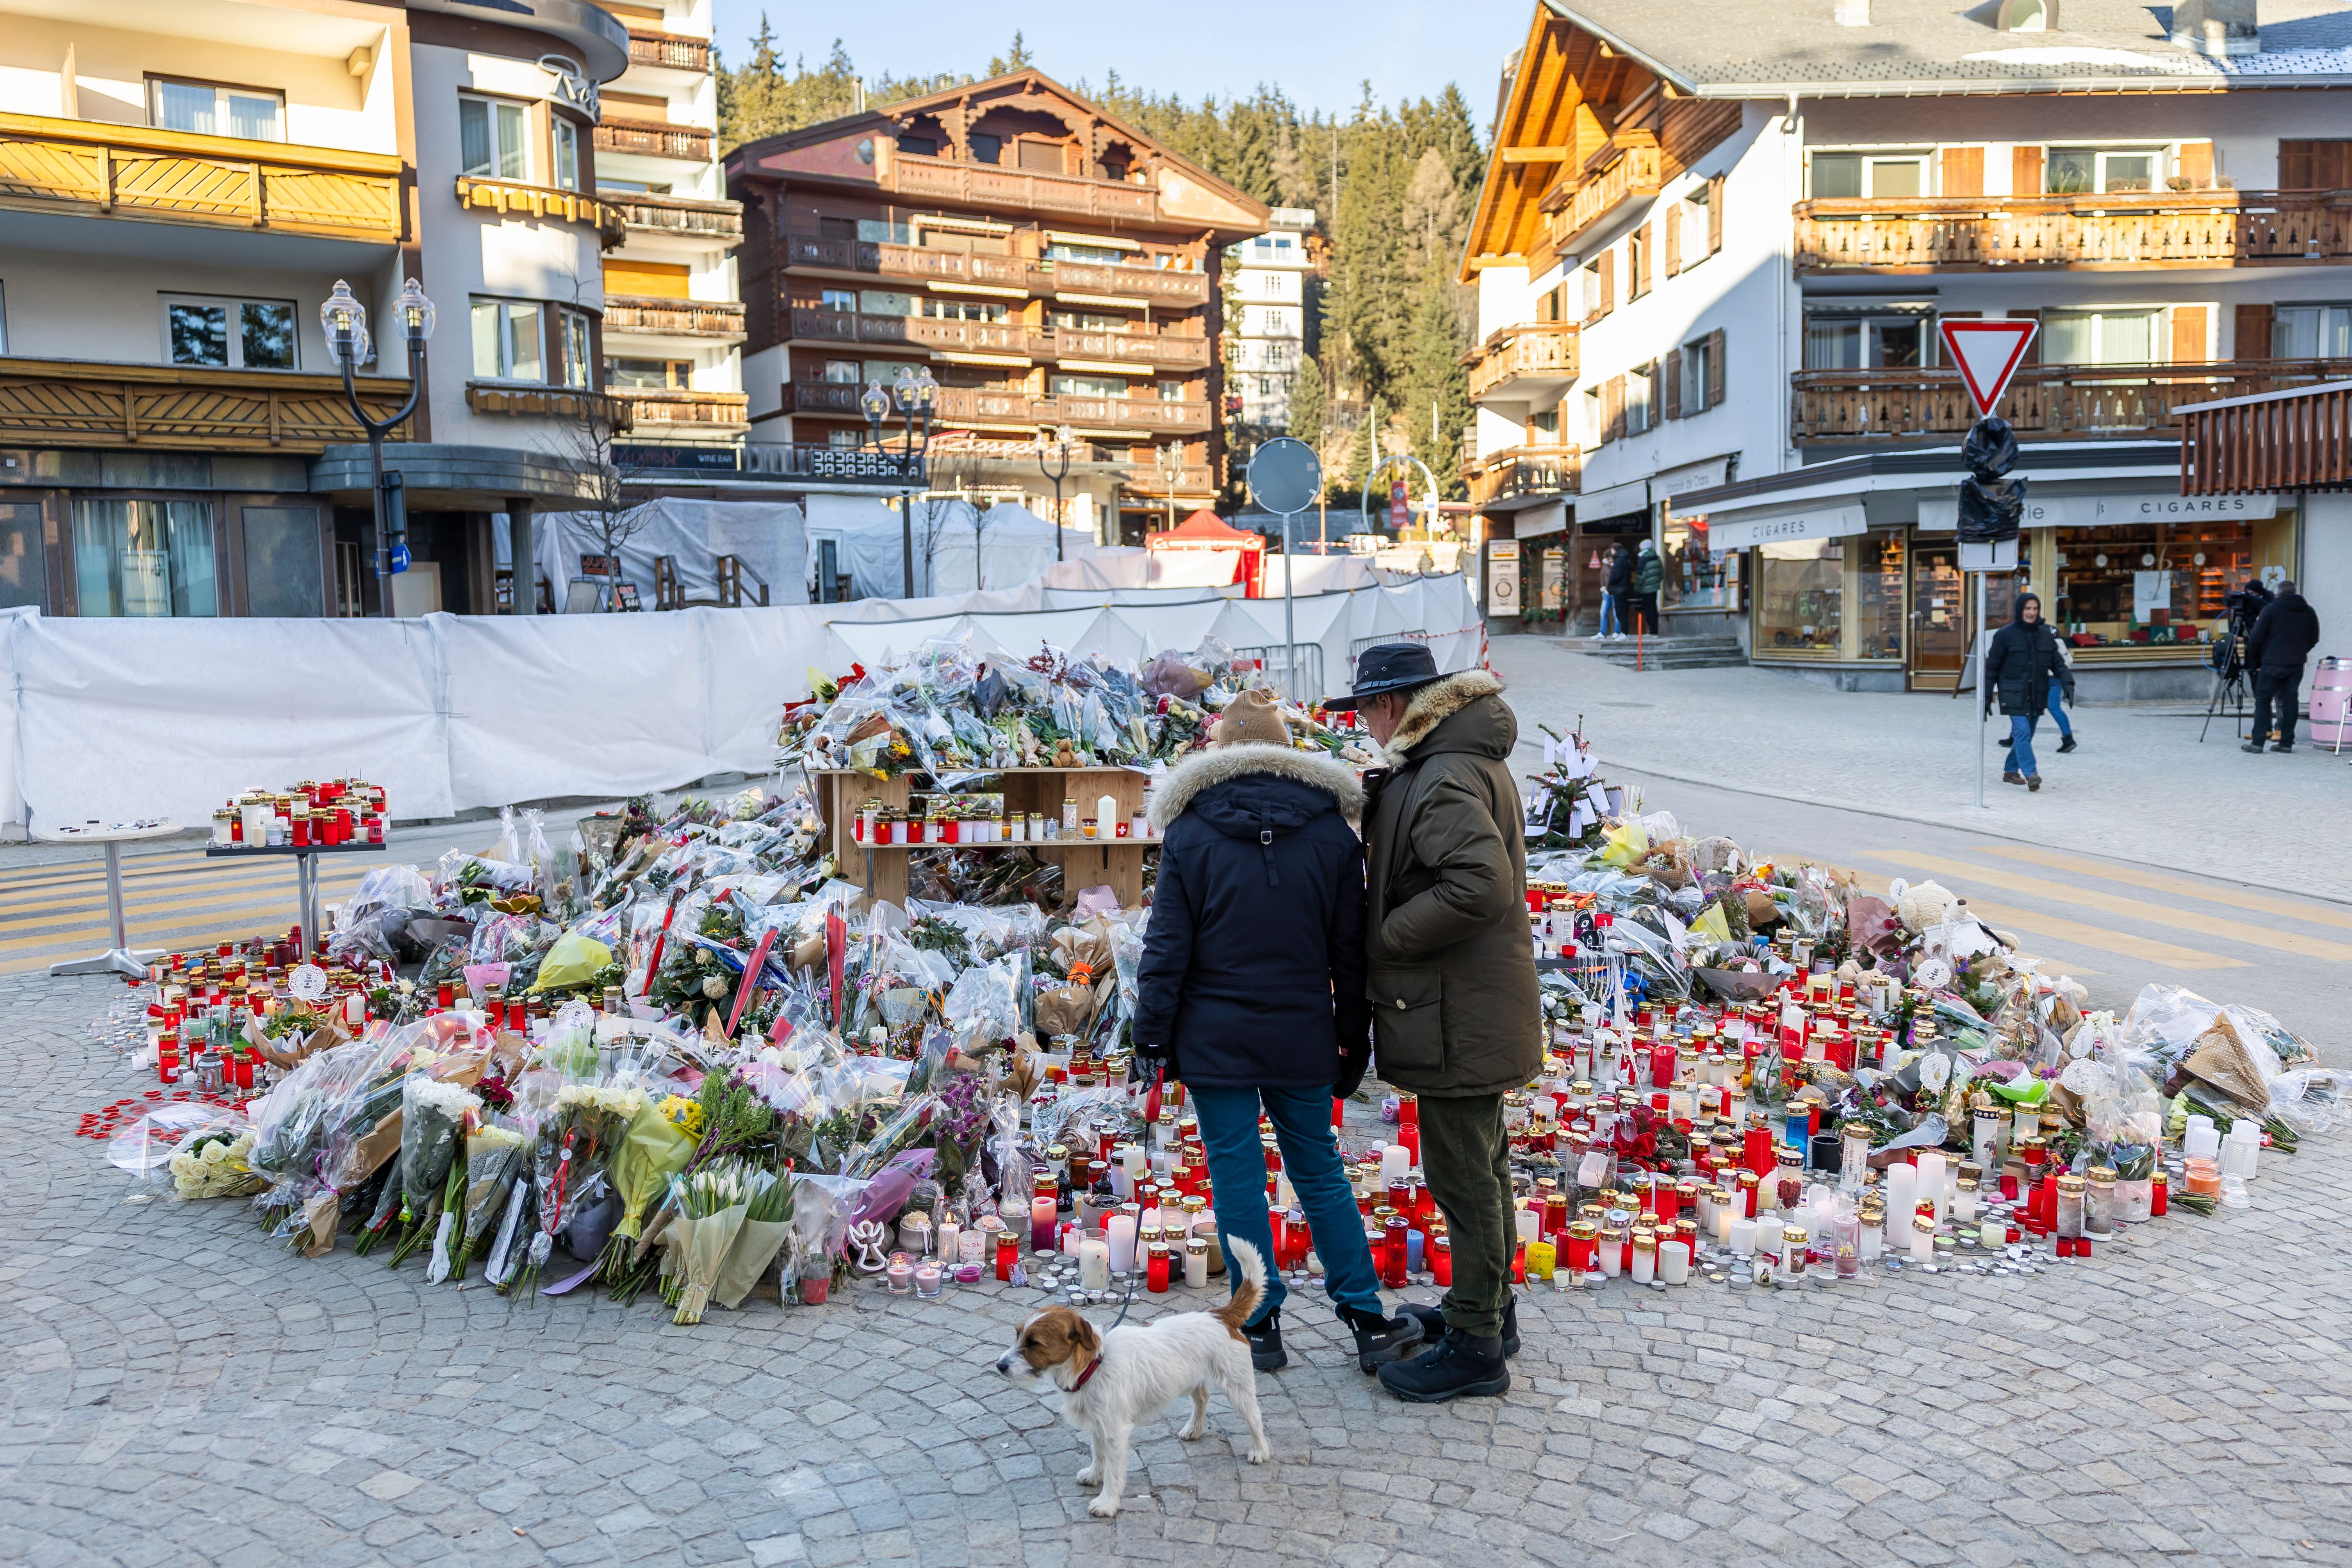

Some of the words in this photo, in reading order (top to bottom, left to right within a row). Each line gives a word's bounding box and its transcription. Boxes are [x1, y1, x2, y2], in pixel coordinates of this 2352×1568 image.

[698, 454, 717, 463] WINE
[718, 454, 733, 463] BAR
[2141, 499, 2245, 513] CIGARES
[1752, 520, 1805, 538] CIGARES
